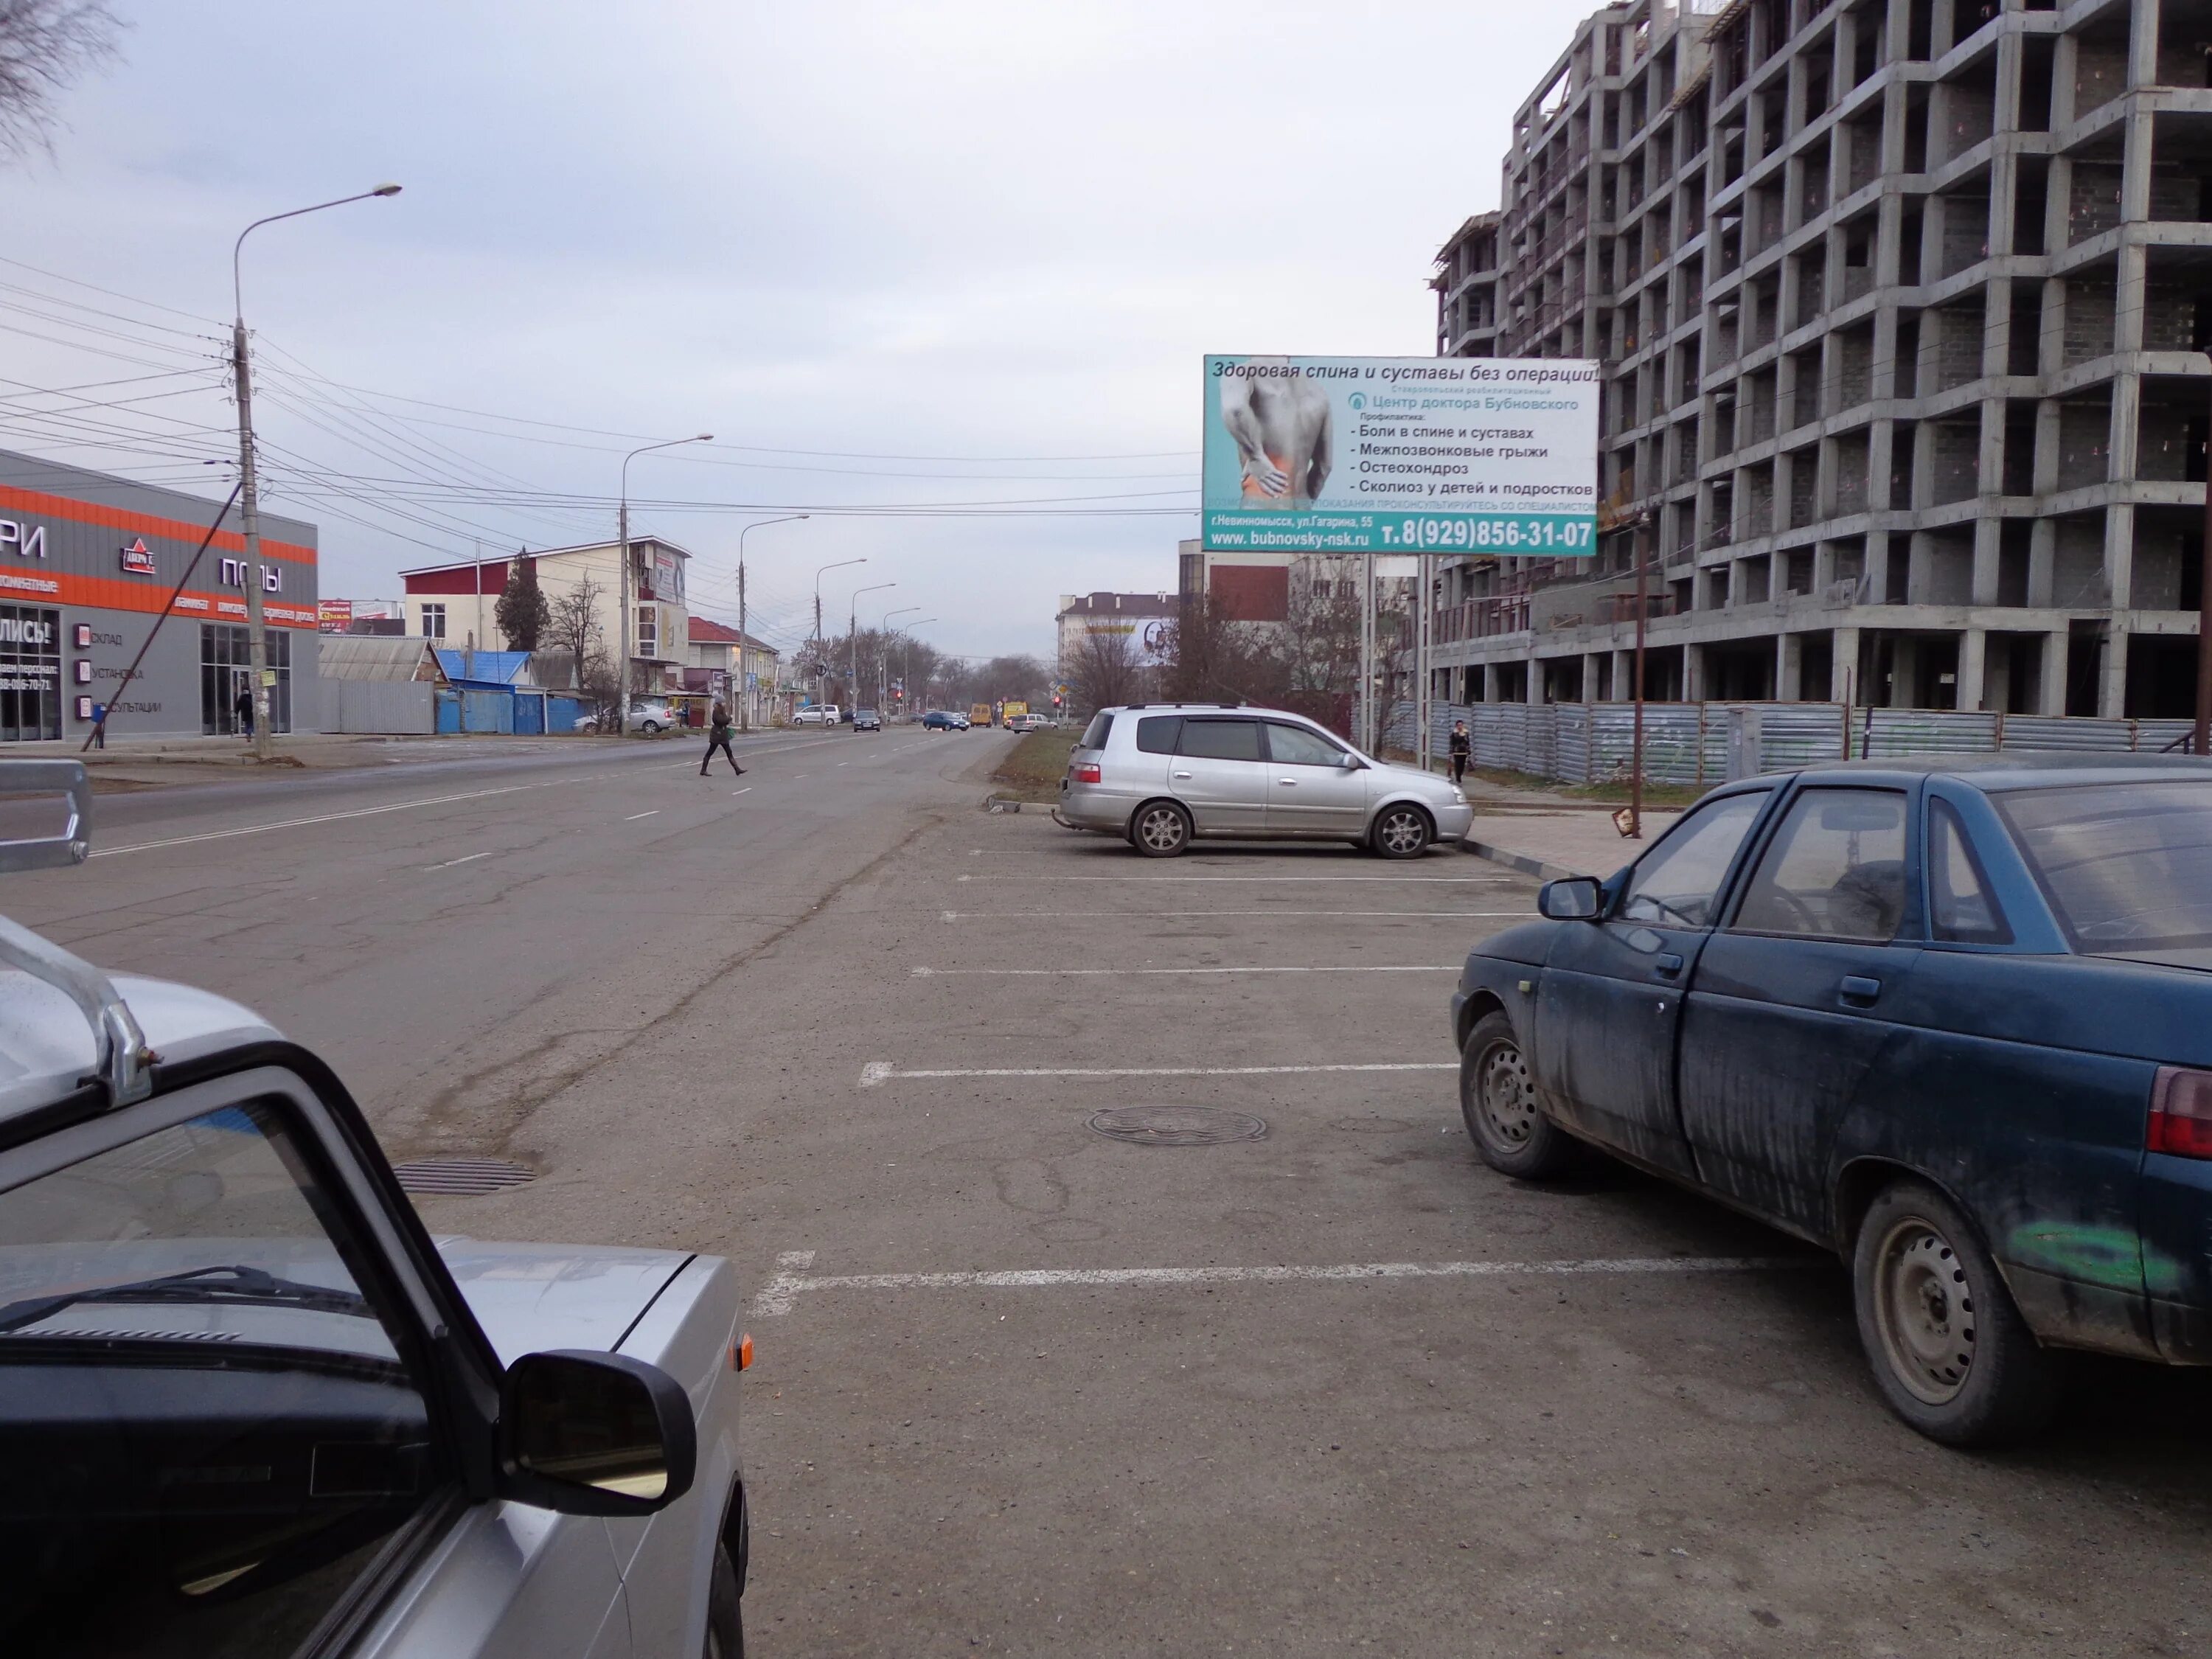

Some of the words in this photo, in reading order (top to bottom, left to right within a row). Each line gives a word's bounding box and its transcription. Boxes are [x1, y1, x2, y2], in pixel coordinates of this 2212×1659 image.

[1212, 362, 1301, 380] Здоровая
[1306, 366, 1358, 379] спина
[1365, 367, 1377, 379] и
[1381, 367, 1464, 383] суставы
[1470, 364, 1500, 380] без
[1506, 367, 1600, 384] операции!
[1373, 396, 1417, 411] Центр
[1421, 399, 1480, 411] доктора
[1485, 397, 1579, 411] Бубновского
[1360, 412, 1425, 422] Профилактика:
[1360, 424, 1396, 437] Боли
[1400, 428, 1408, 437] в
[1413, 428, 1454, 438] спине
[1458, 429, 1467, 438] и
[1471, 429, 1534, 442] суставах
[1360, 443, 1494, 456] Межпозвонковые
[1499, 448, 1548, 460] грыжи
[1360, 460, 1469, 476] Остеохондроз
[1359, 479, 1423, 493] Сколиоз
[1427, 484, 1436, 495] у
[1440, 481, 1484, 495] детей
[1489, 484, 1498, 494] и
[1503, 484, 1593, 497] подростков
[1361, 516, 1373, 527] 55
[1211, 533, 1247, 545] www.
[1251, 531, 1369, 549] bubnovsky-nsk.ru
[91, 632, 122, 645] СКЛАД
